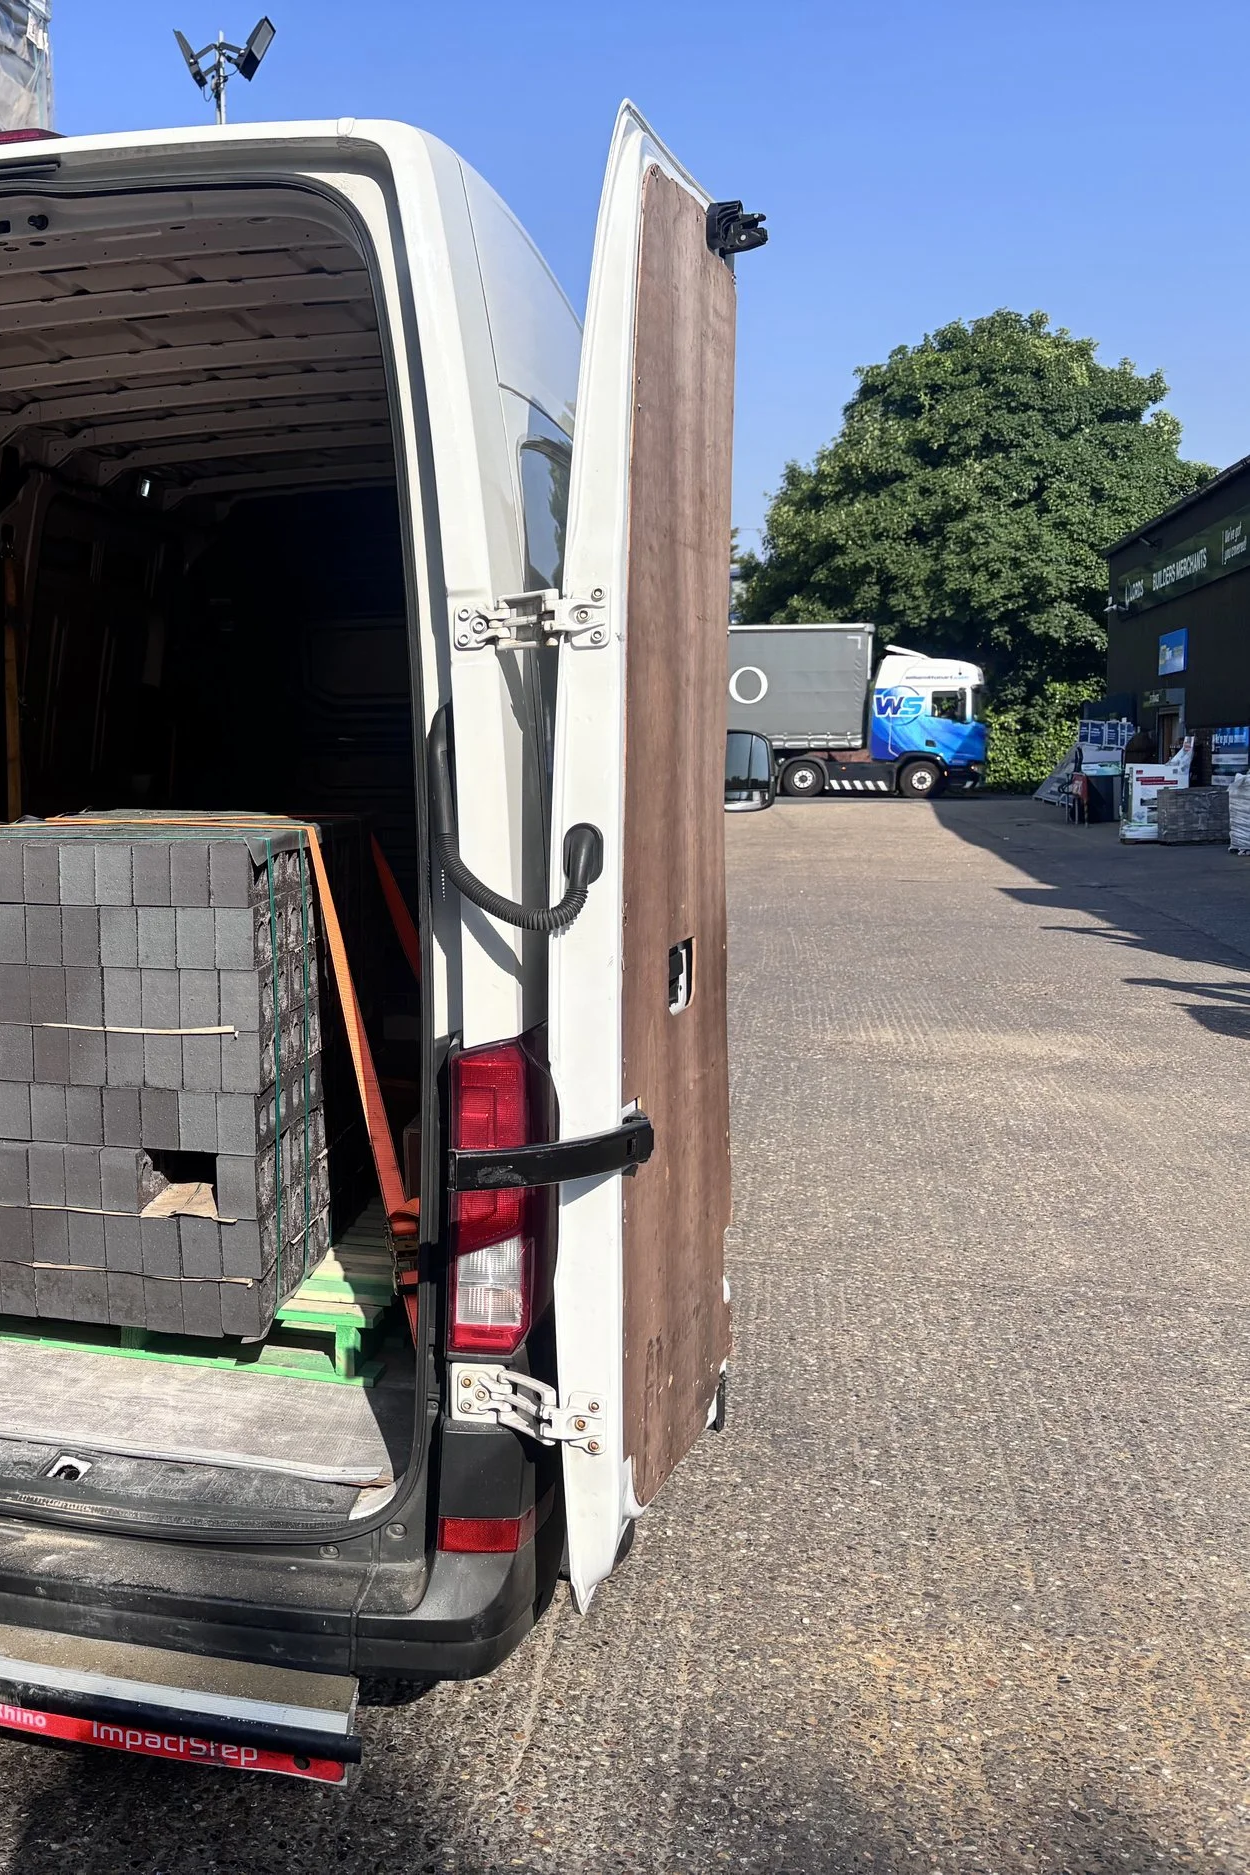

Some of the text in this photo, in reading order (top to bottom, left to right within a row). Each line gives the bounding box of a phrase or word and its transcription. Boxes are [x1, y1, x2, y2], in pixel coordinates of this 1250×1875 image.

[1152, 563, 1176, 592] BUILDERS
[1175, 547, 1208, 581] MERCHANTS
[729, 666, 768, 704] O
[874, 695, 925, 716] WS
